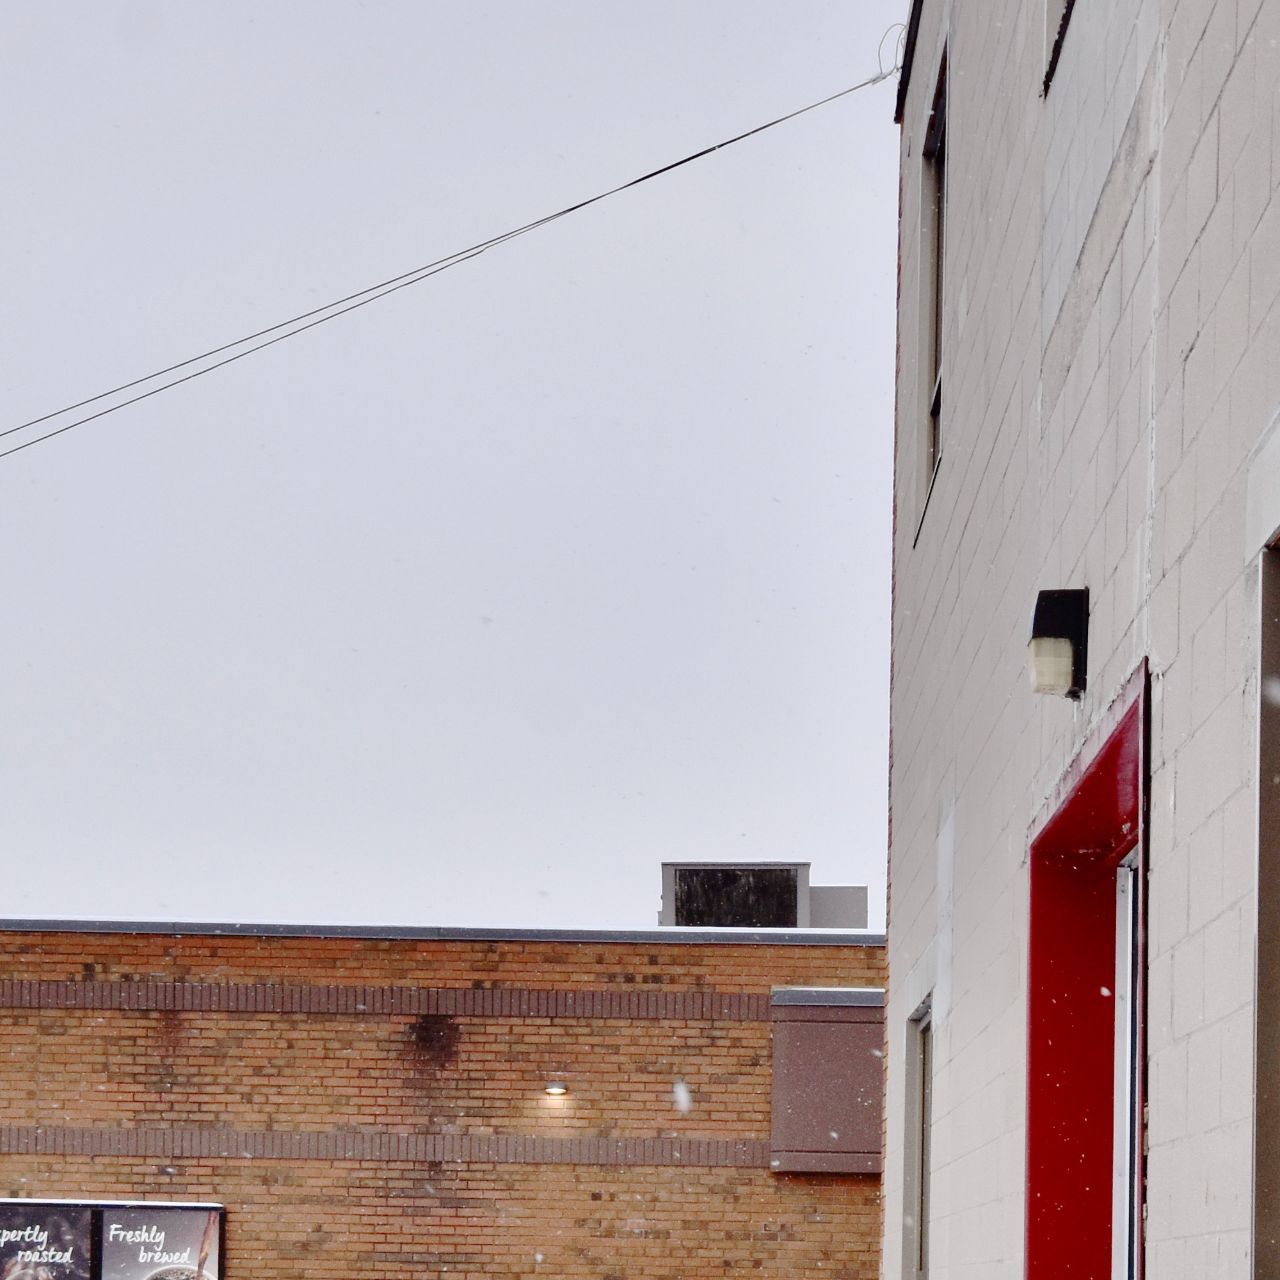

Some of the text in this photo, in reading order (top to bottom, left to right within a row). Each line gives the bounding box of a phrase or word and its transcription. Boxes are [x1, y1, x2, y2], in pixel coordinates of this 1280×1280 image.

[109, 1223, 165, 1251] Freshly
[16, 1247, 74, 1263] roasted
[138, 1246, 191, 1264] brewed
